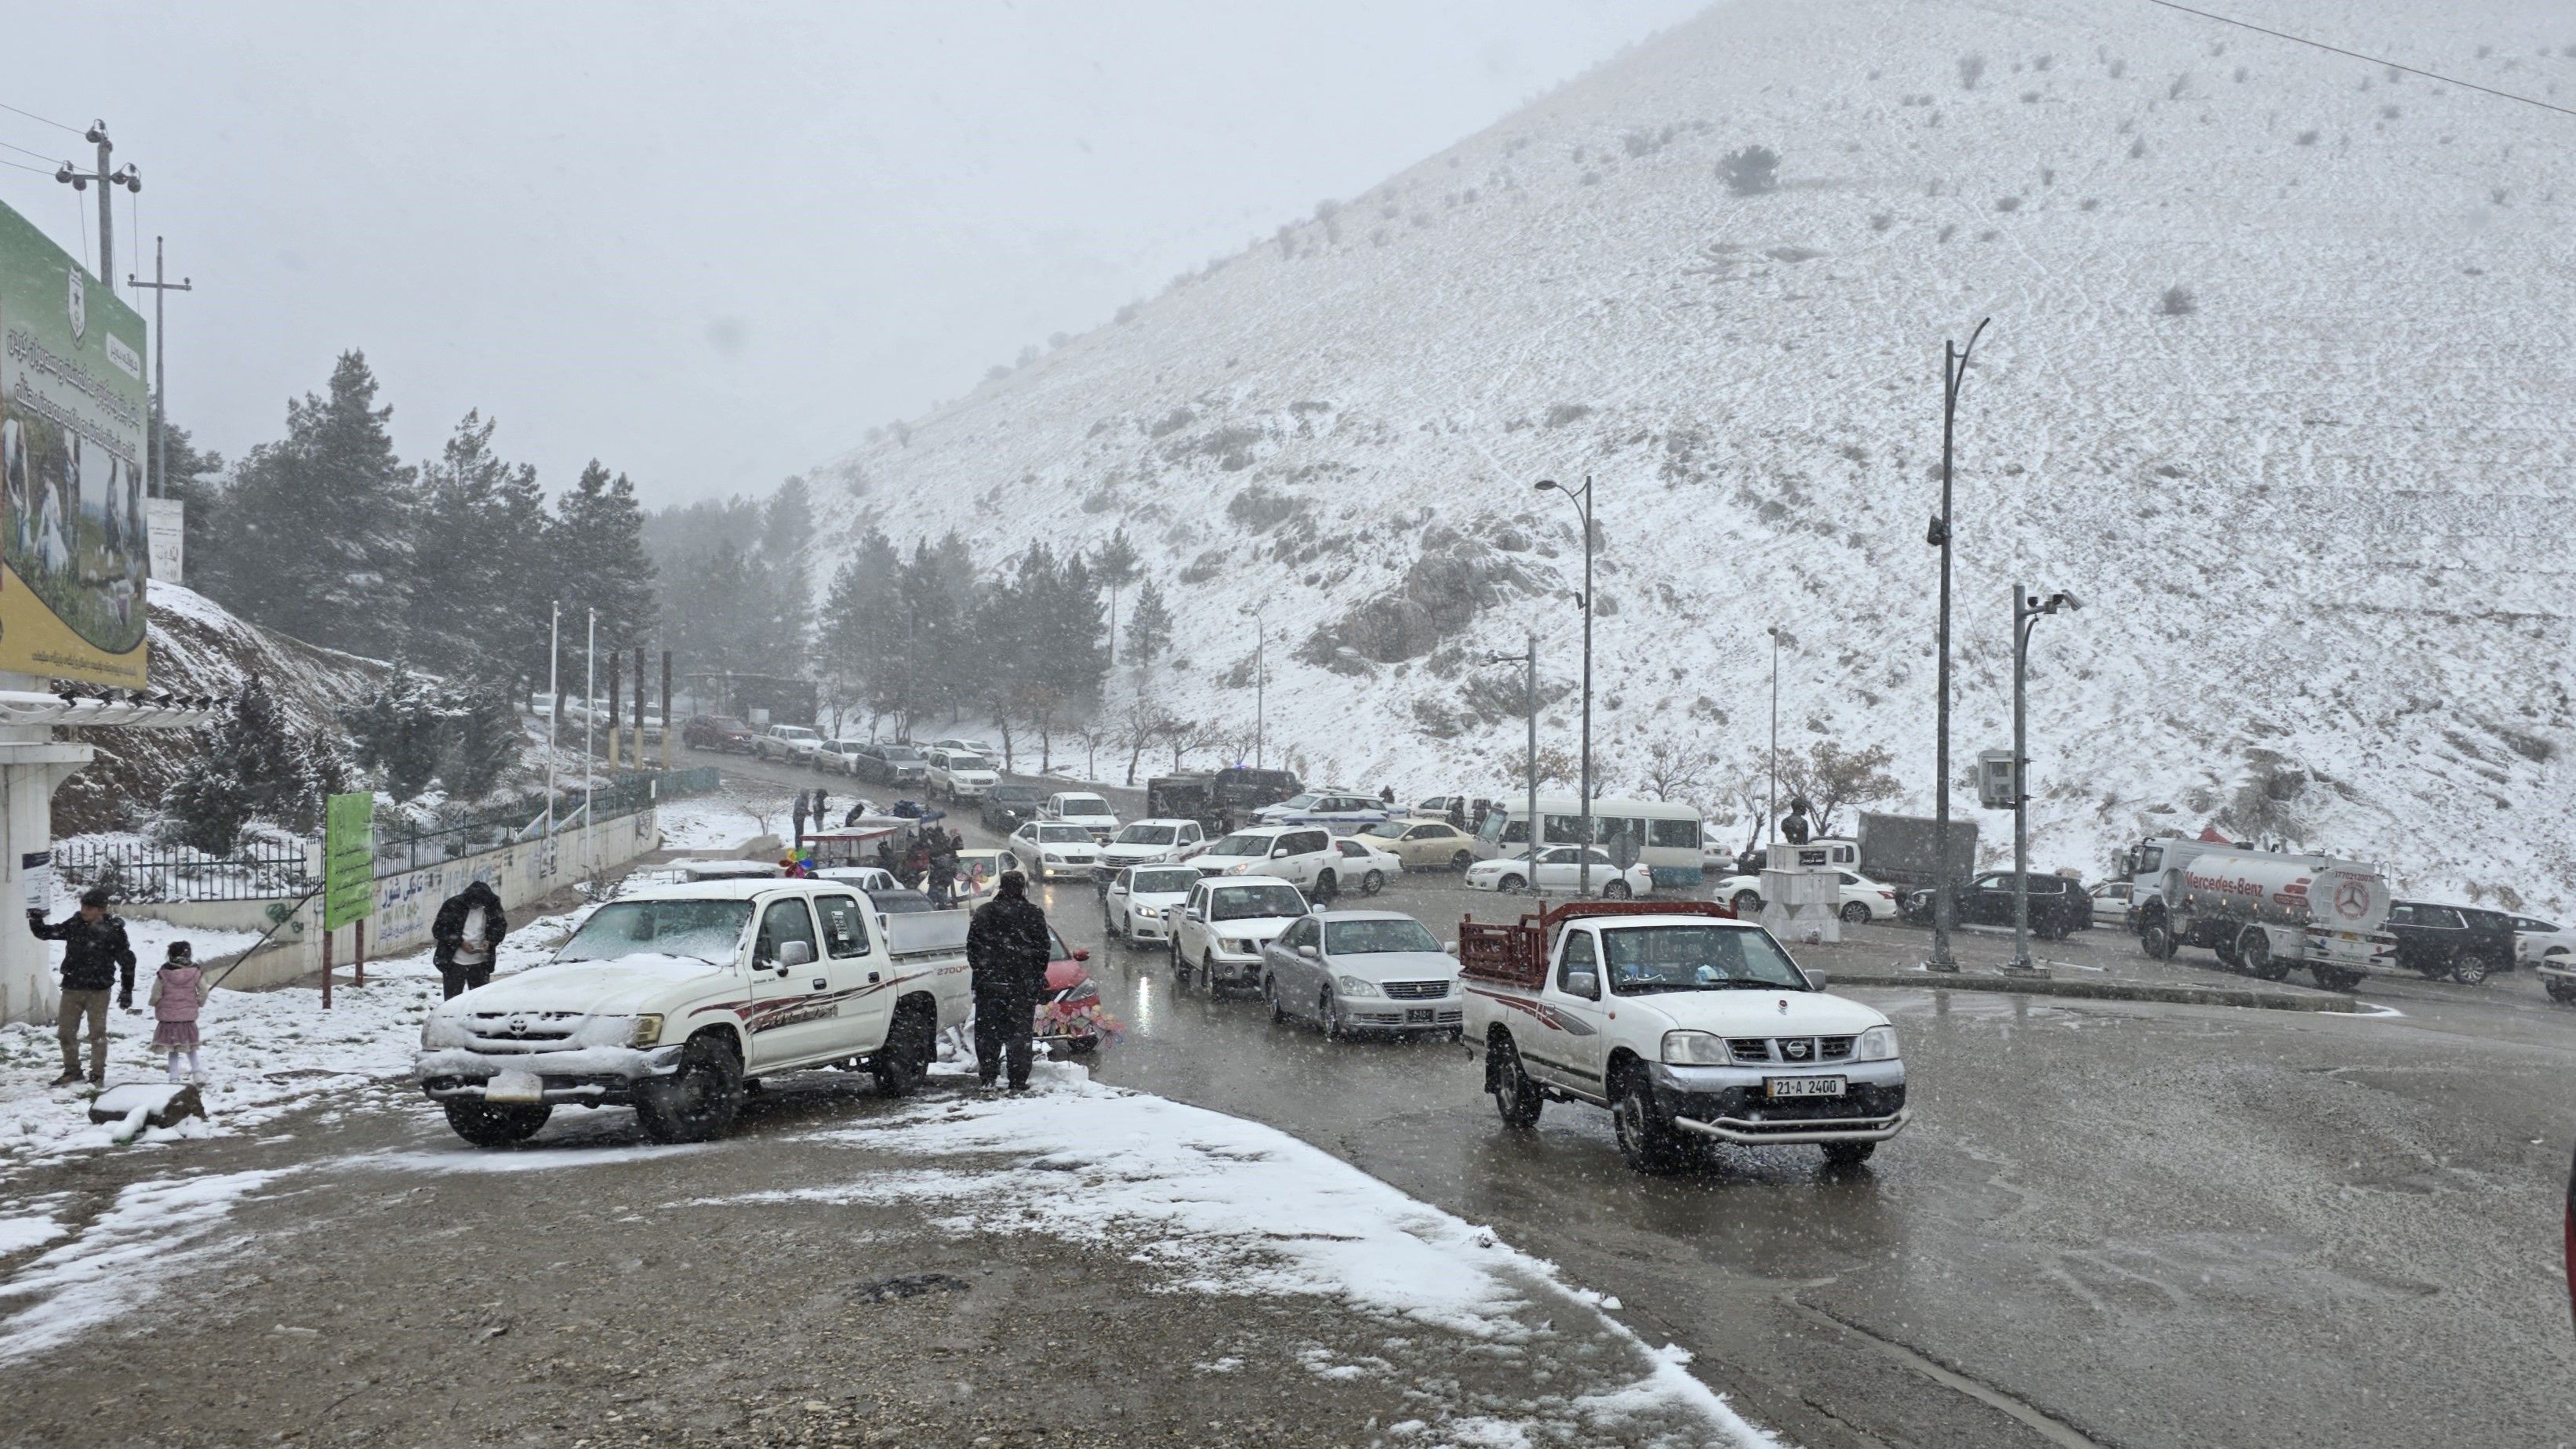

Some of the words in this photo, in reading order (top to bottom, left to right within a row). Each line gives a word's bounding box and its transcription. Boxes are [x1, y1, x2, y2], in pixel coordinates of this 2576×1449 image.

[7, 329, 27, 361] کردن
[28, 337, 57, 374] سەیران
[58, 358, 64, 384] و
[2185, 870, 2264, 897] Mercedes-Benz
[1809, 1080, 1836, 1094] 2400
